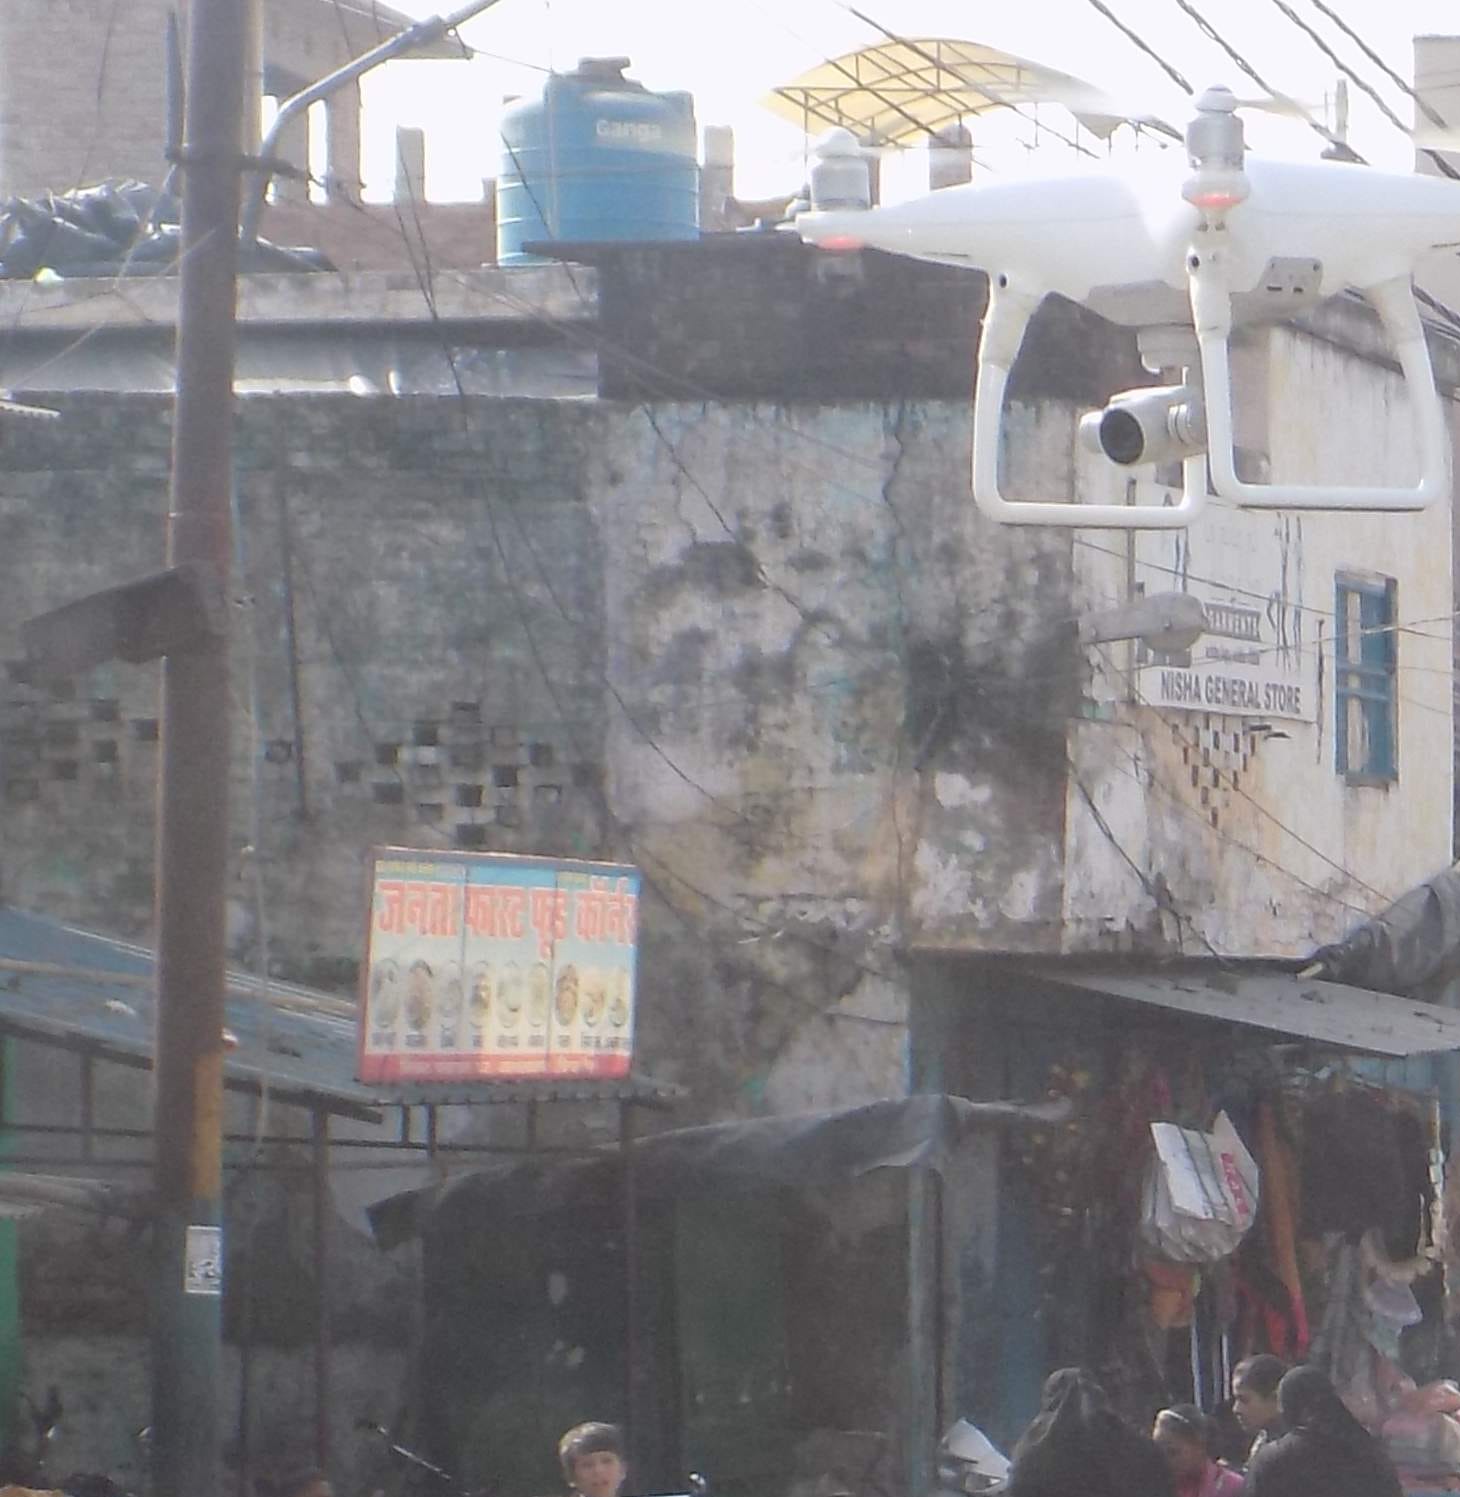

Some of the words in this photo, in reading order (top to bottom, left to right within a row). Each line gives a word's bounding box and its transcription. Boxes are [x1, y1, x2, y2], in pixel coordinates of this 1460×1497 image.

[1160, 671, 1201, 700] NISHA
[1204, 675, 1261, 709] GENERAL
[1264, 683, 1301, 714] STORE
